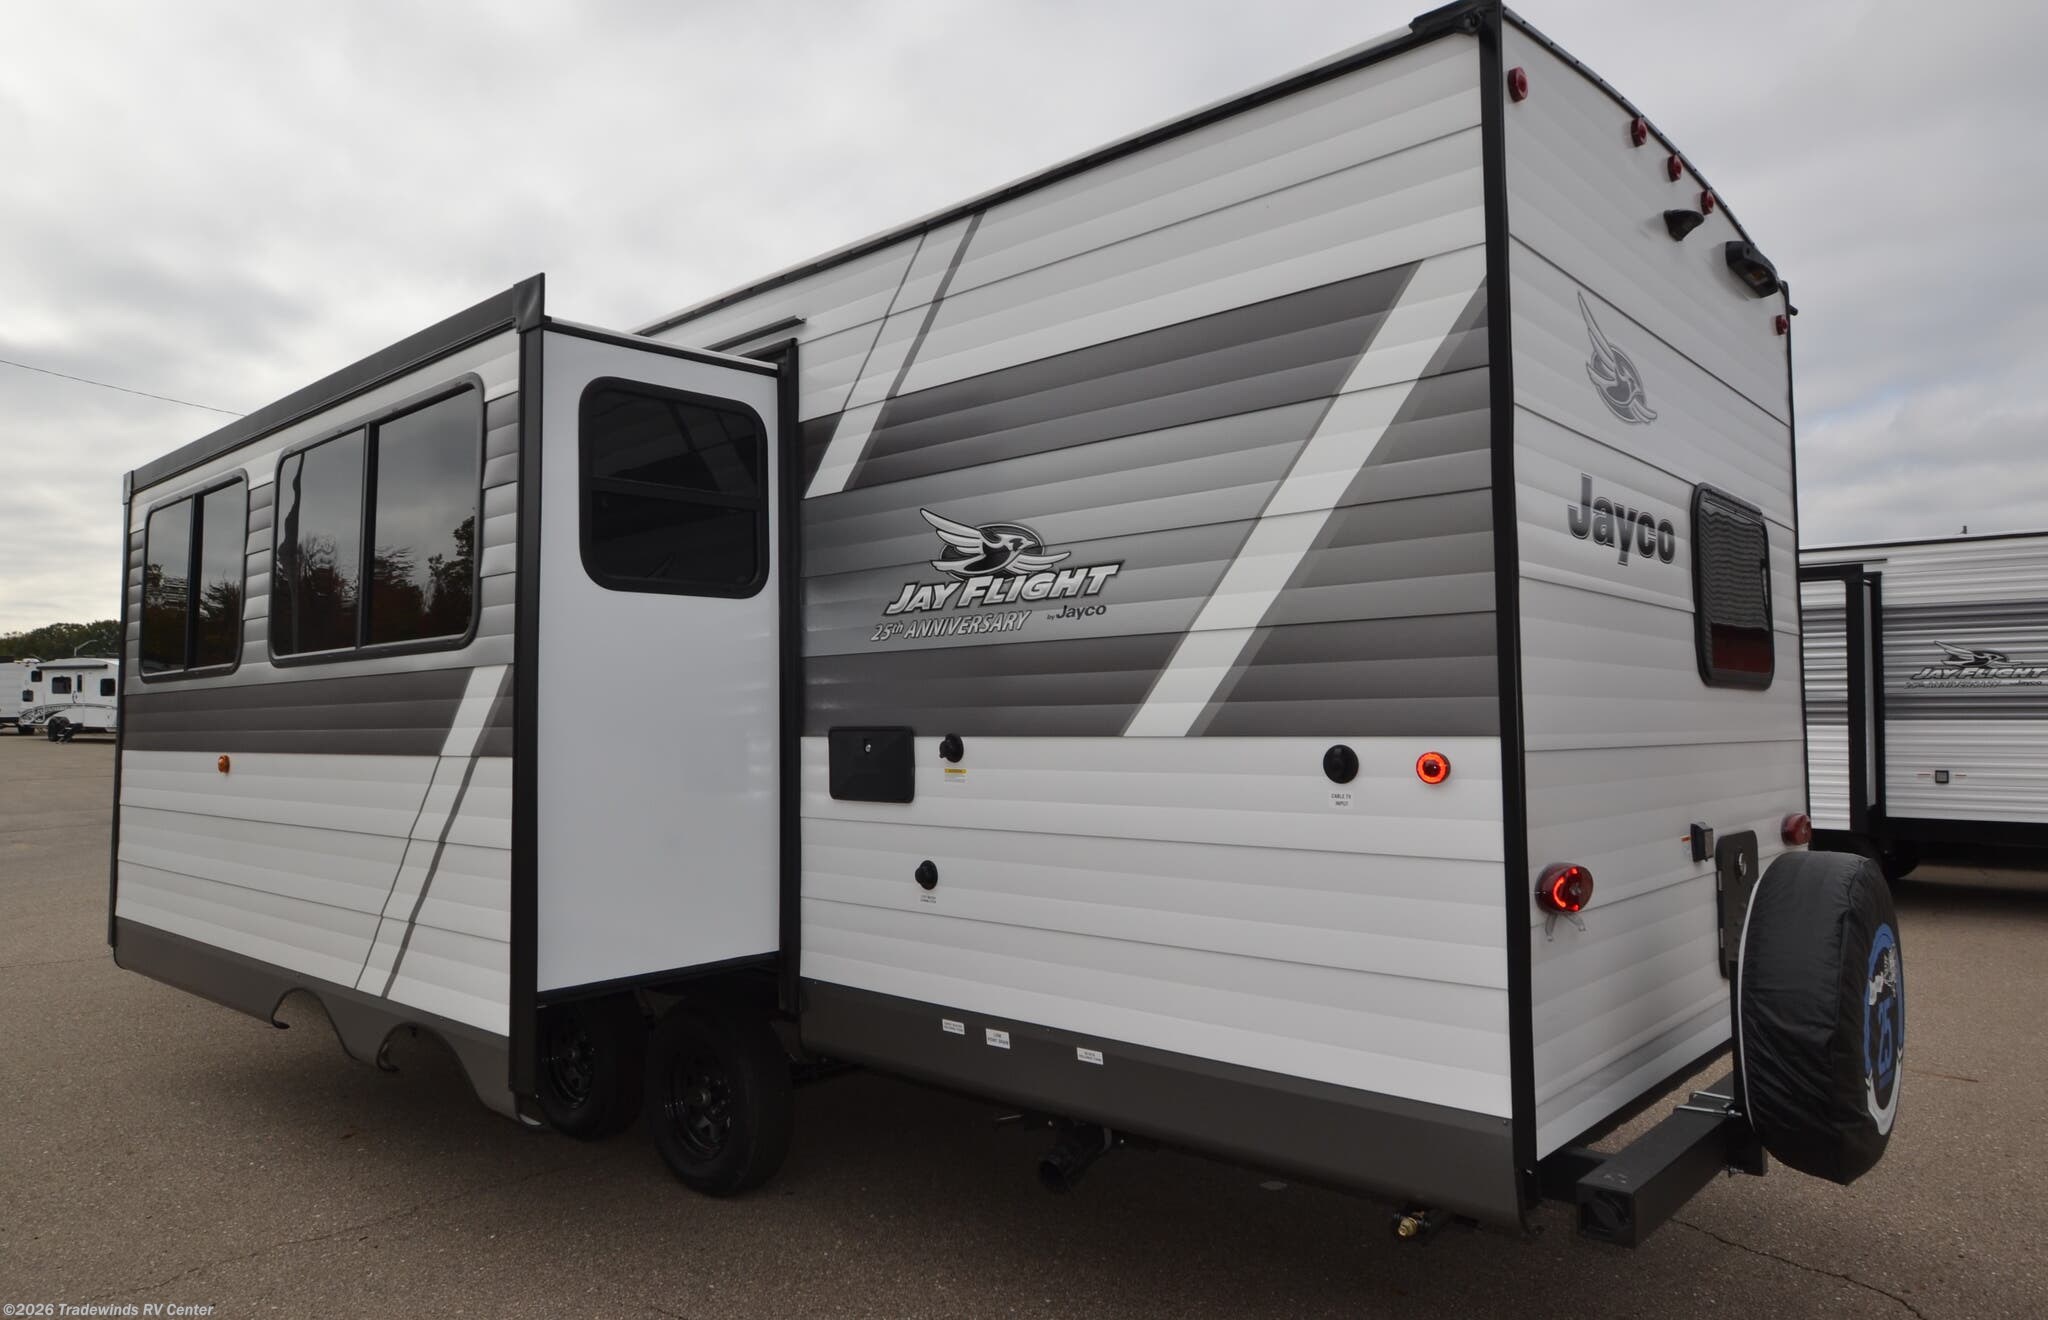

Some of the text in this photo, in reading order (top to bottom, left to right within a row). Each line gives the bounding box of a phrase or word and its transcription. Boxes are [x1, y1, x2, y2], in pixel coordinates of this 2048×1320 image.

[1567, 472, 1675, 567] Jayco
[881, 560, 1125, 617] JAY FLIGHT
[871, 610, 1032, 641] 25th ANNIVERSARY
[1056, 604, 1106, 620] Jayco
[1911, 666, 2048, 680] JAY FLIGHT
